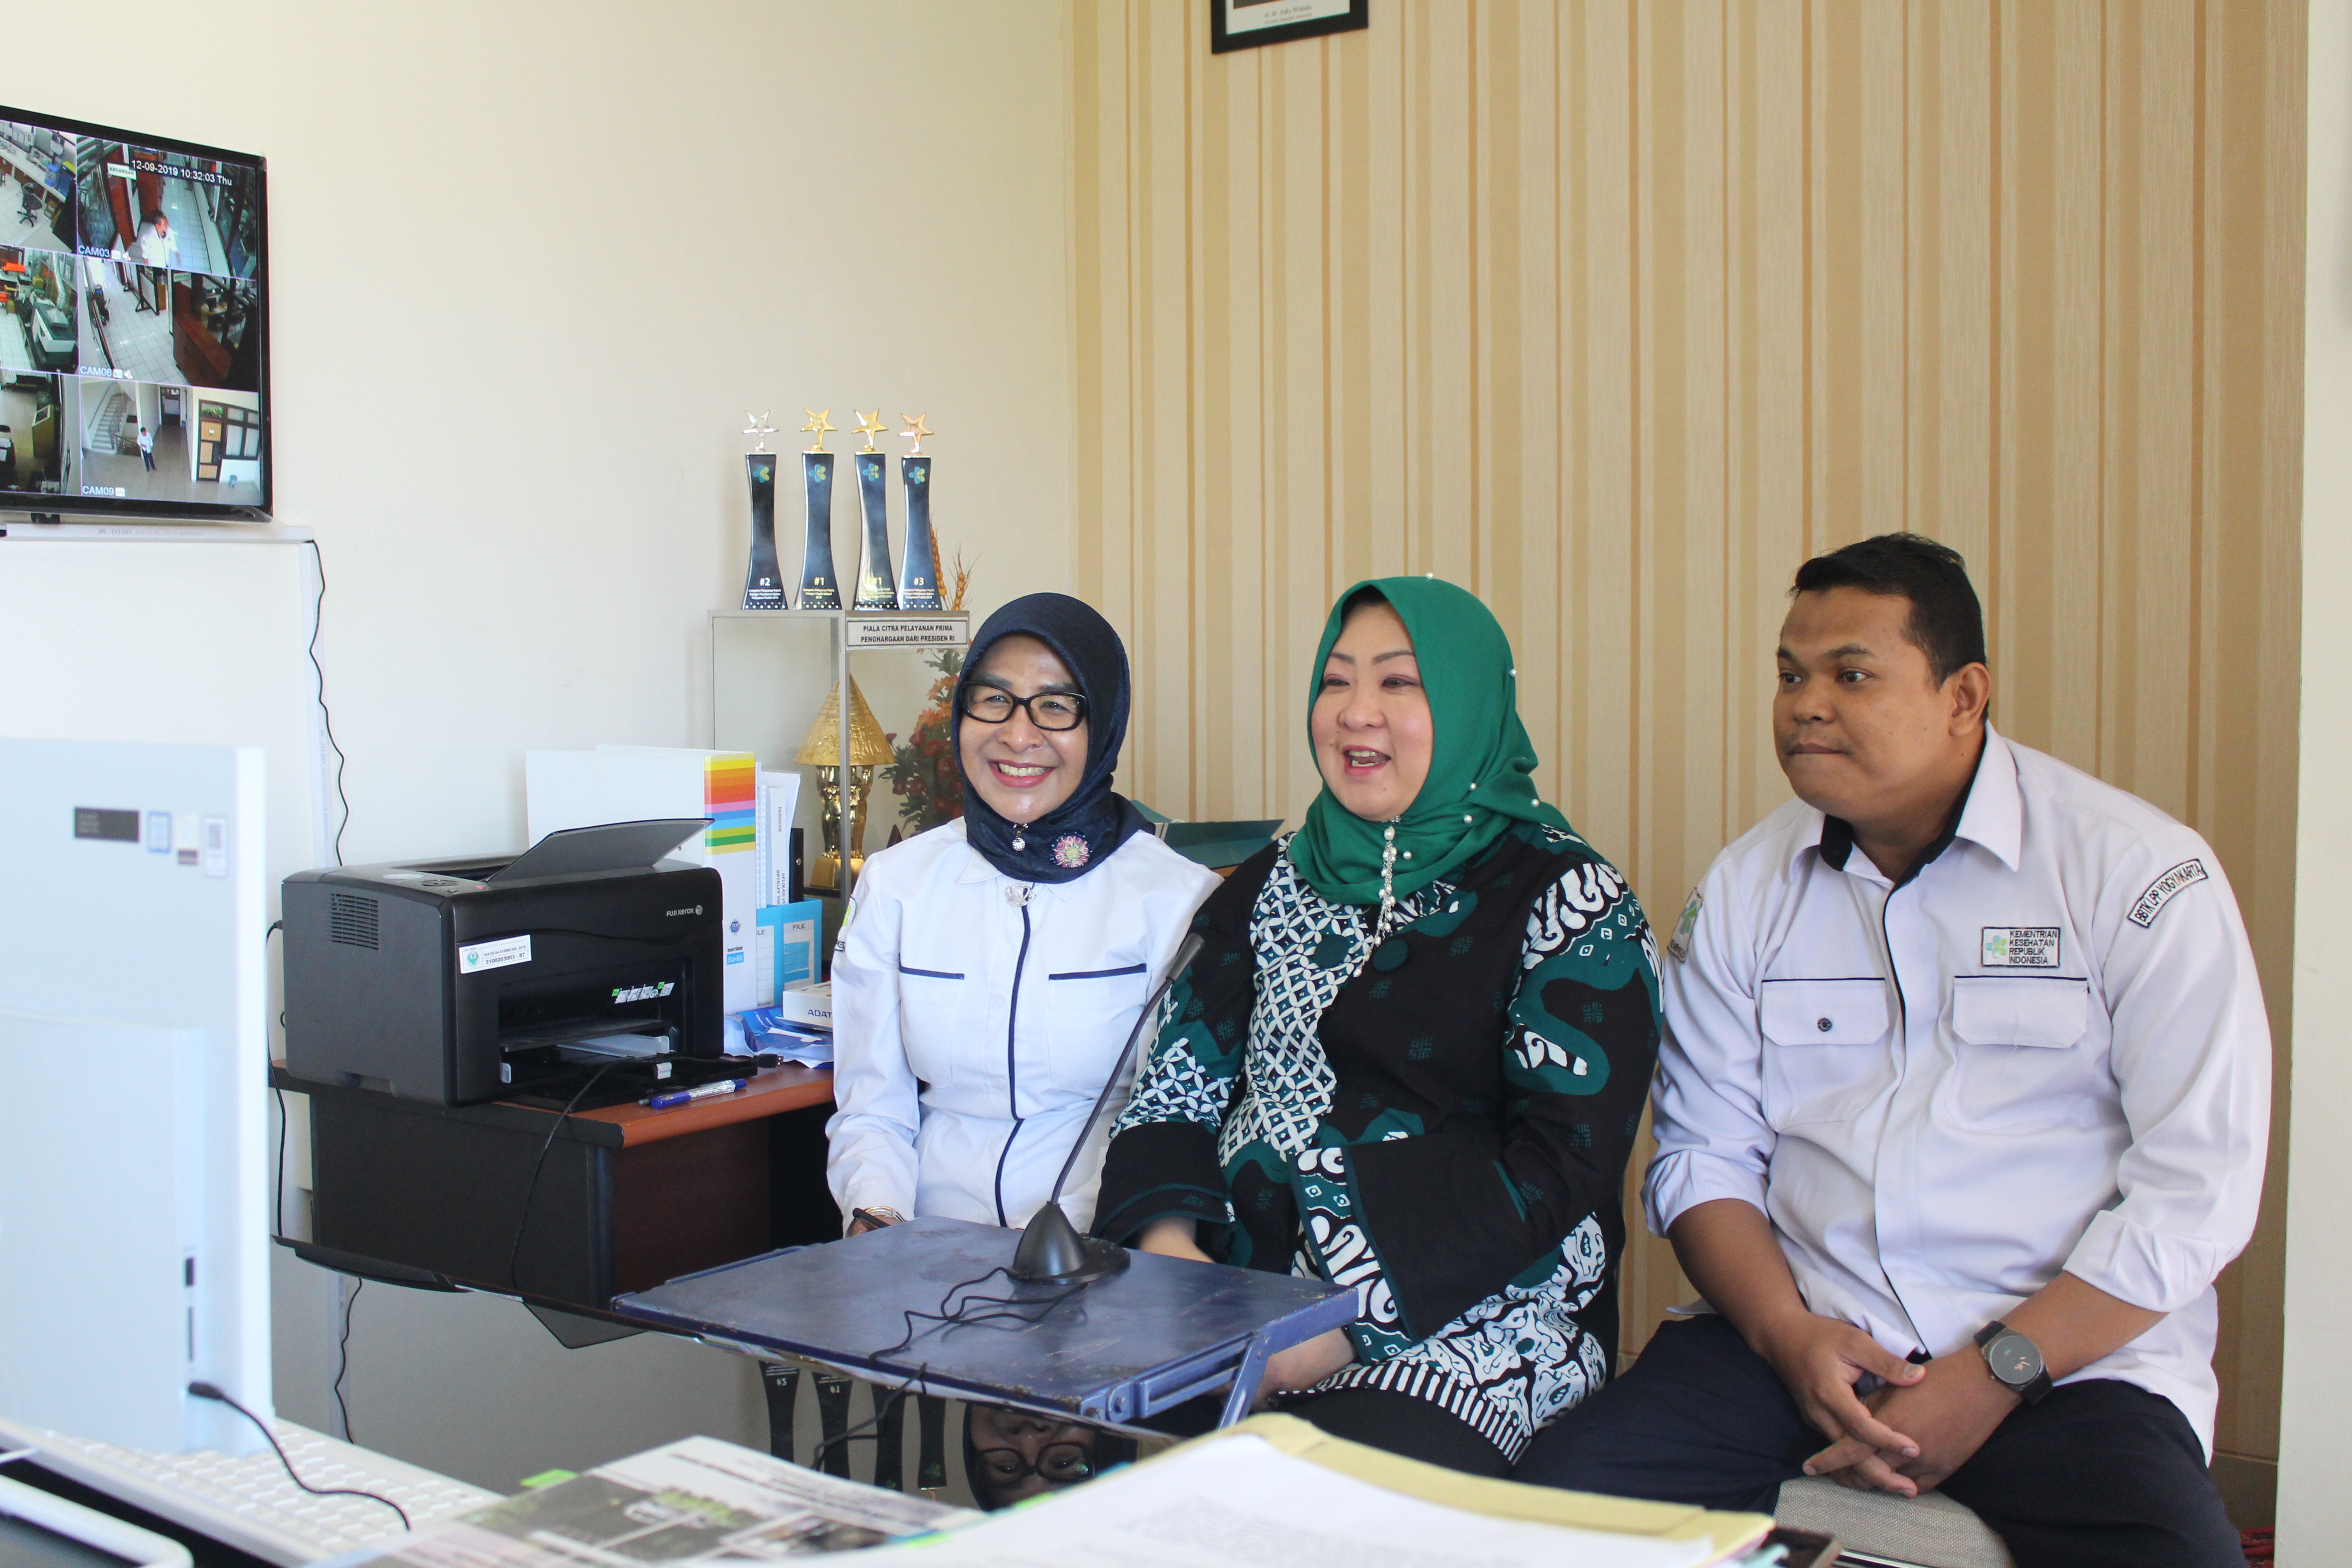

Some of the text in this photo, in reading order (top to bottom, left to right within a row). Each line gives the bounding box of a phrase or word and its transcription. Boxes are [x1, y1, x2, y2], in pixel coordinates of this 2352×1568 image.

[131, 159, 233, 186] 12-09-2019 10:32:03 Thu
[78, 245, 110, 258] CAM03
[80, 365, 112, 377] CAM06
[82, 485, 114, 496] CAM09
[759, 577, 771, 586] #2
[814, 577, 824, 586] #1
[913, 577, 925, 586] #3
[2134, 863, 2205, 922] BBTK LPP YOGYAKARTA
[485, 954, 515, 965] 3100203003
[2009, 956, 2048, 964] INDONESIA
